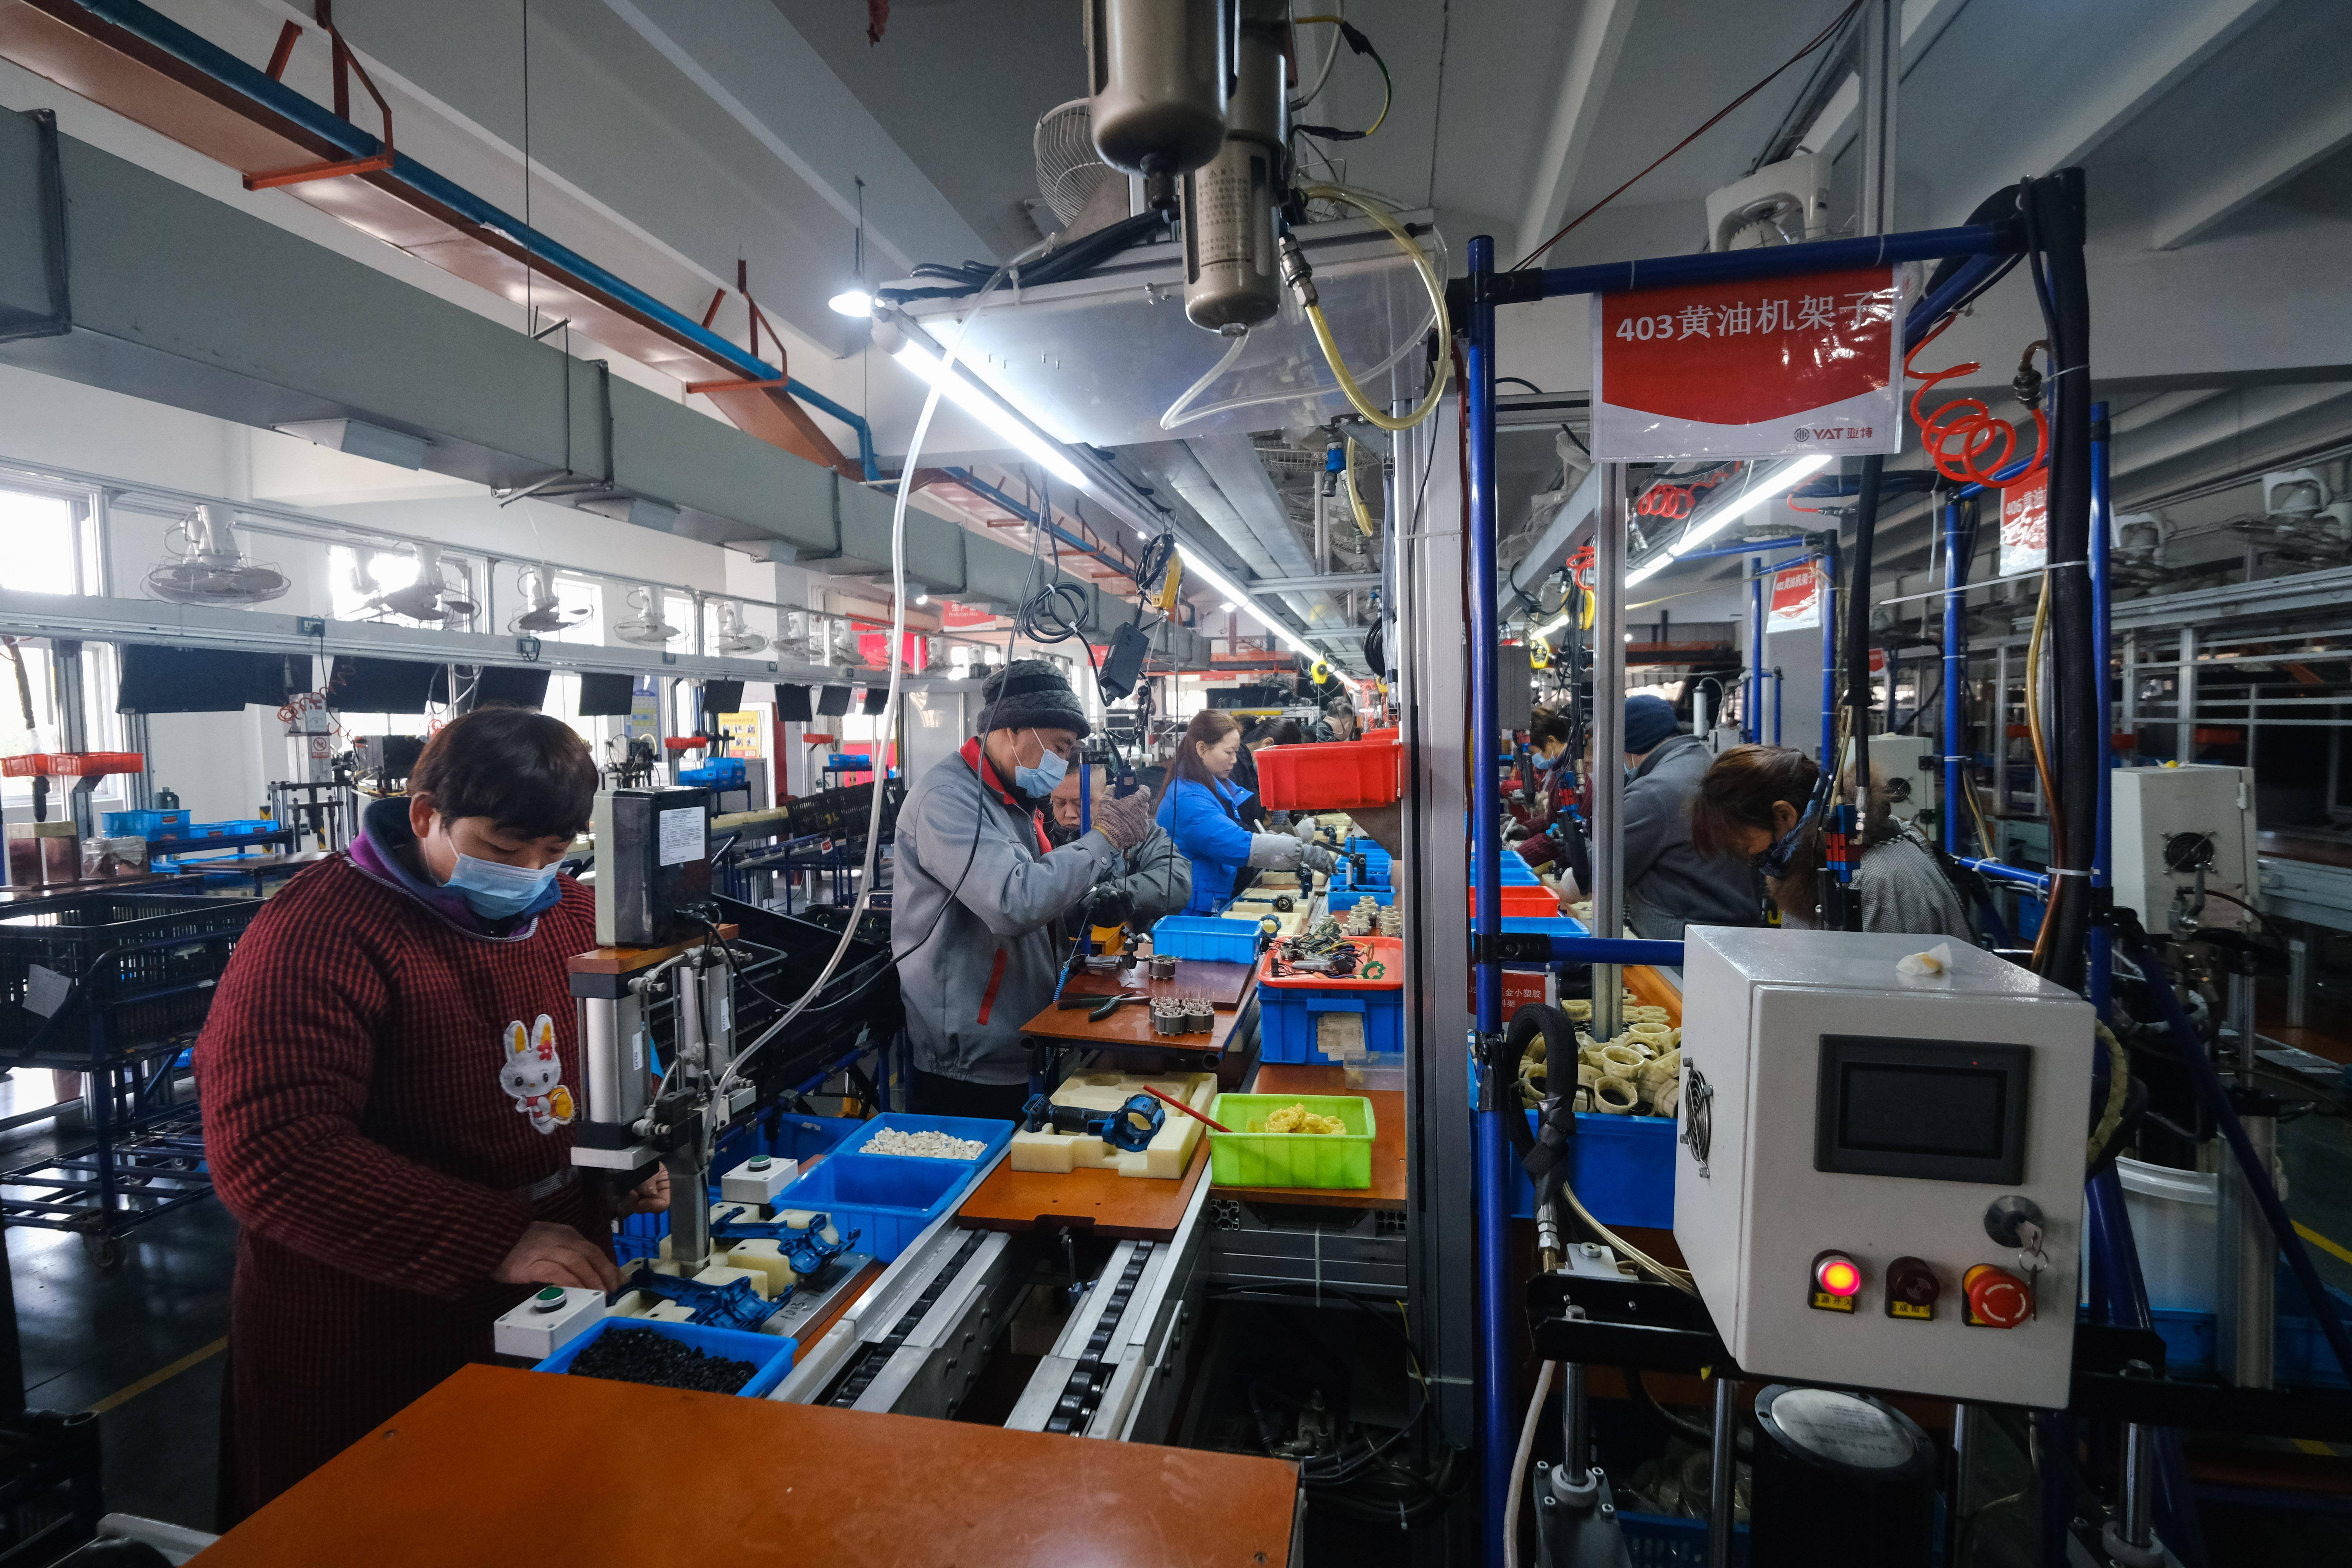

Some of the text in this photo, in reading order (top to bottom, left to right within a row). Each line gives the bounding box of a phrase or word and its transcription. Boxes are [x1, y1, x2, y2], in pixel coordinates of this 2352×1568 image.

[1616, 290, 1884, 342] 403黄油机架子
[1813, 427, 1873, 439] YAT 亚特
[2005, 484, 2047, 516] 406黄油
[1815, 1295, 1852, 1307] 源开关
[1893, 1303, 1930, 1314] 成指示
